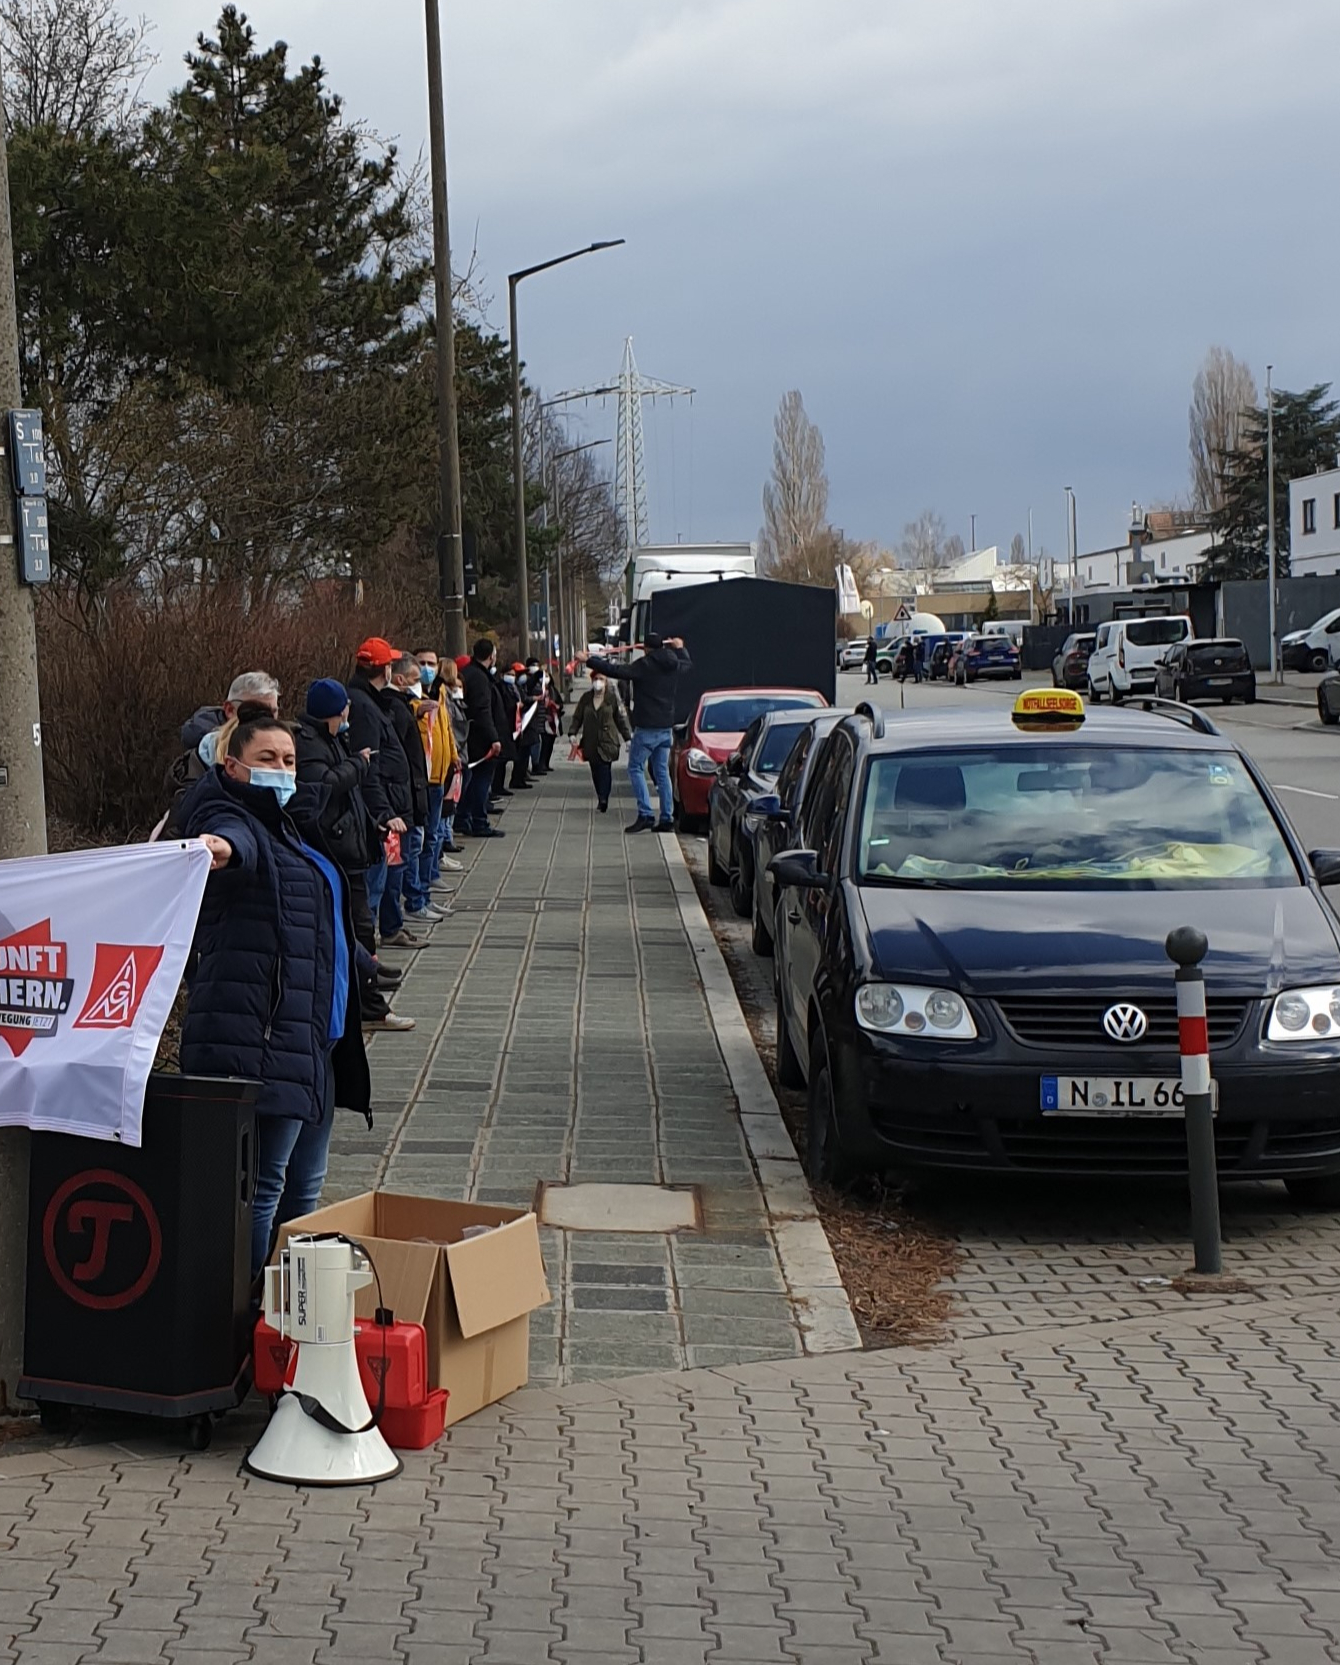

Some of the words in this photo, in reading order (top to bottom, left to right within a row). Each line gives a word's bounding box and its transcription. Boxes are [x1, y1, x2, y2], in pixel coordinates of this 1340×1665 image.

[16, 421, 24, 440] S
[23, 508, 30, 528] T
[32, 722, 41, 747] 5
[1071, 1080, 1089, 1106] N
[1111, 1081, 1146, 1106] IL
[298, 1290, 307, 1326] SUPER
